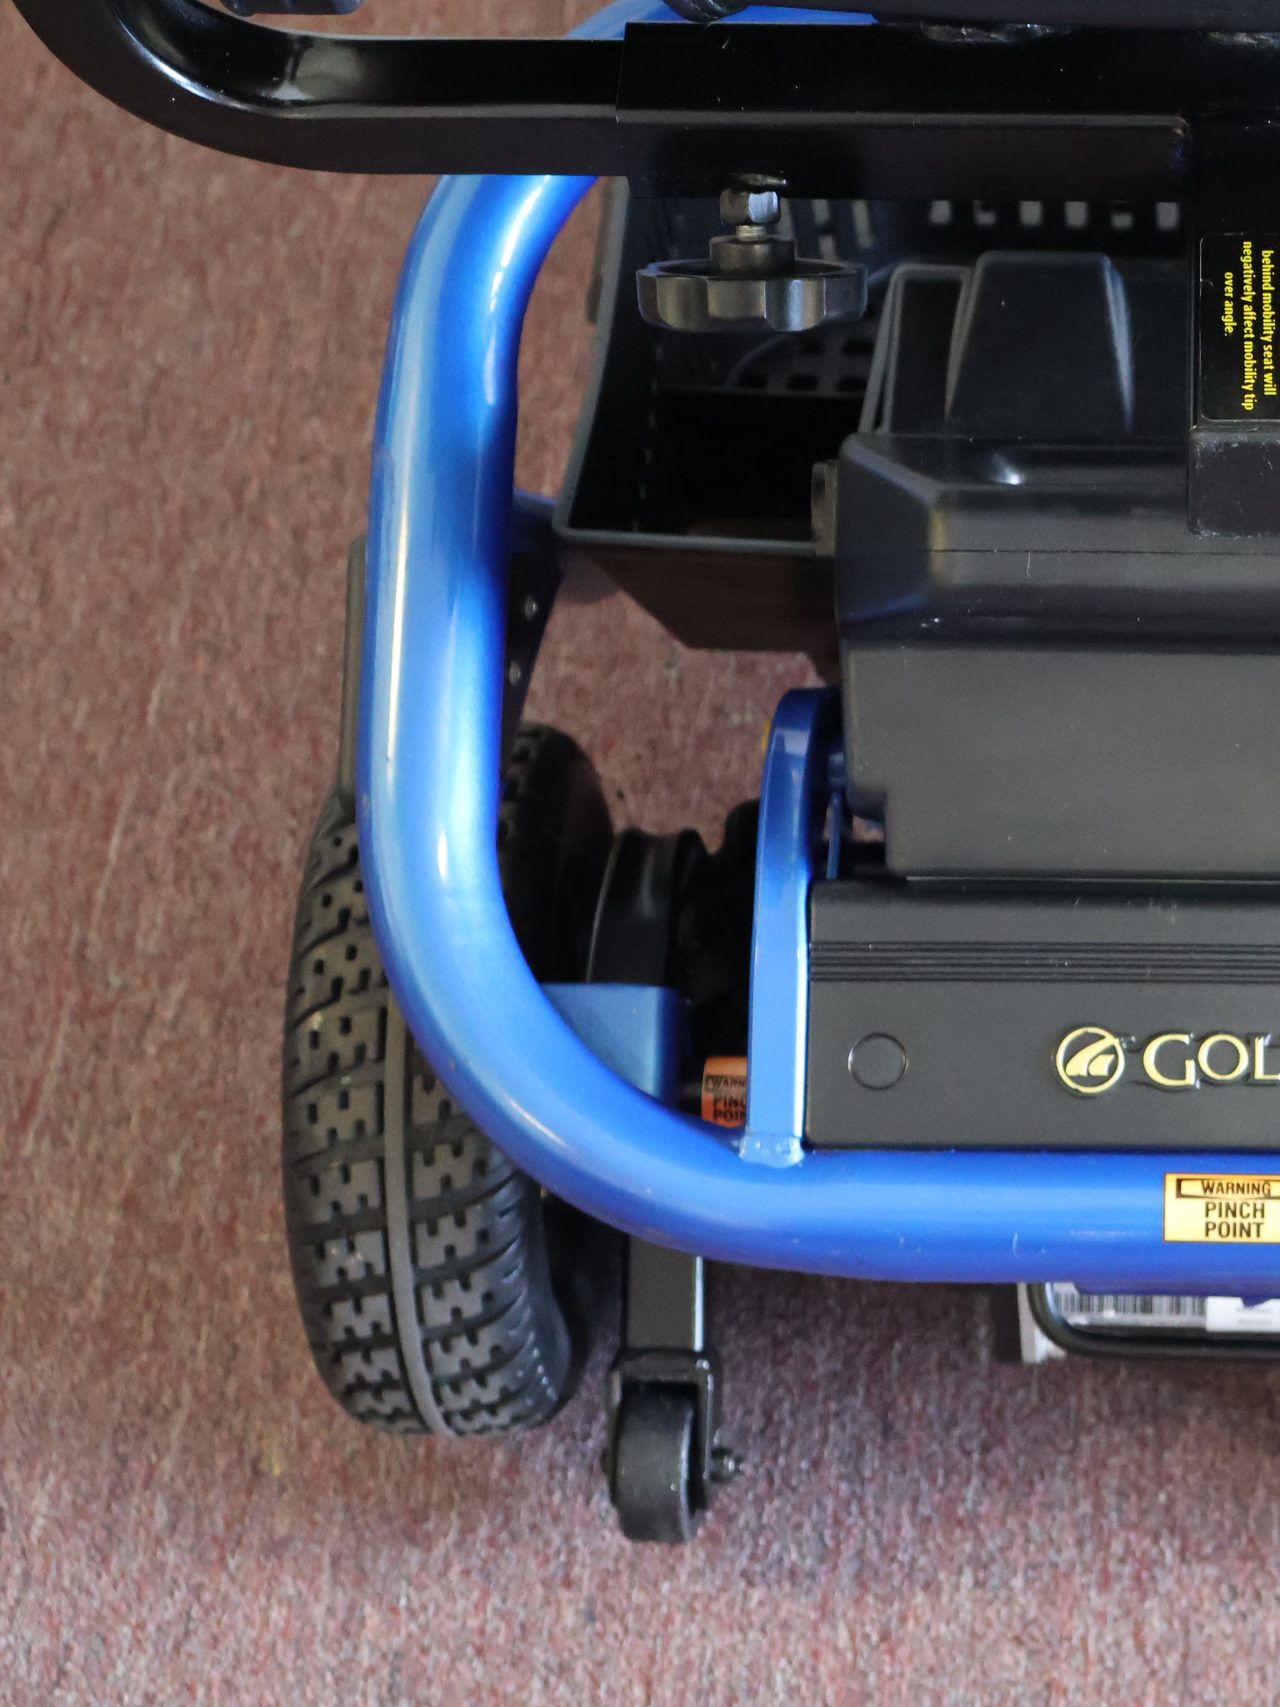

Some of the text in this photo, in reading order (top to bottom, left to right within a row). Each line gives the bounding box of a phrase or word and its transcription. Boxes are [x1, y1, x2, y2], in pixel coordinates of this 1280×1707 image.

[1221, 271, 1237, 337] over angle.
[1260, 249, 1277, 396] behind mobility seat will
[1240, 241, 1257, 411] negatively affect mobility tip
[1201, 1180, 1271, 1197] WARNING
[1204, 1201, 1266, 1219] PINCH
[1204, 1221, 1265, 1239] POINT
